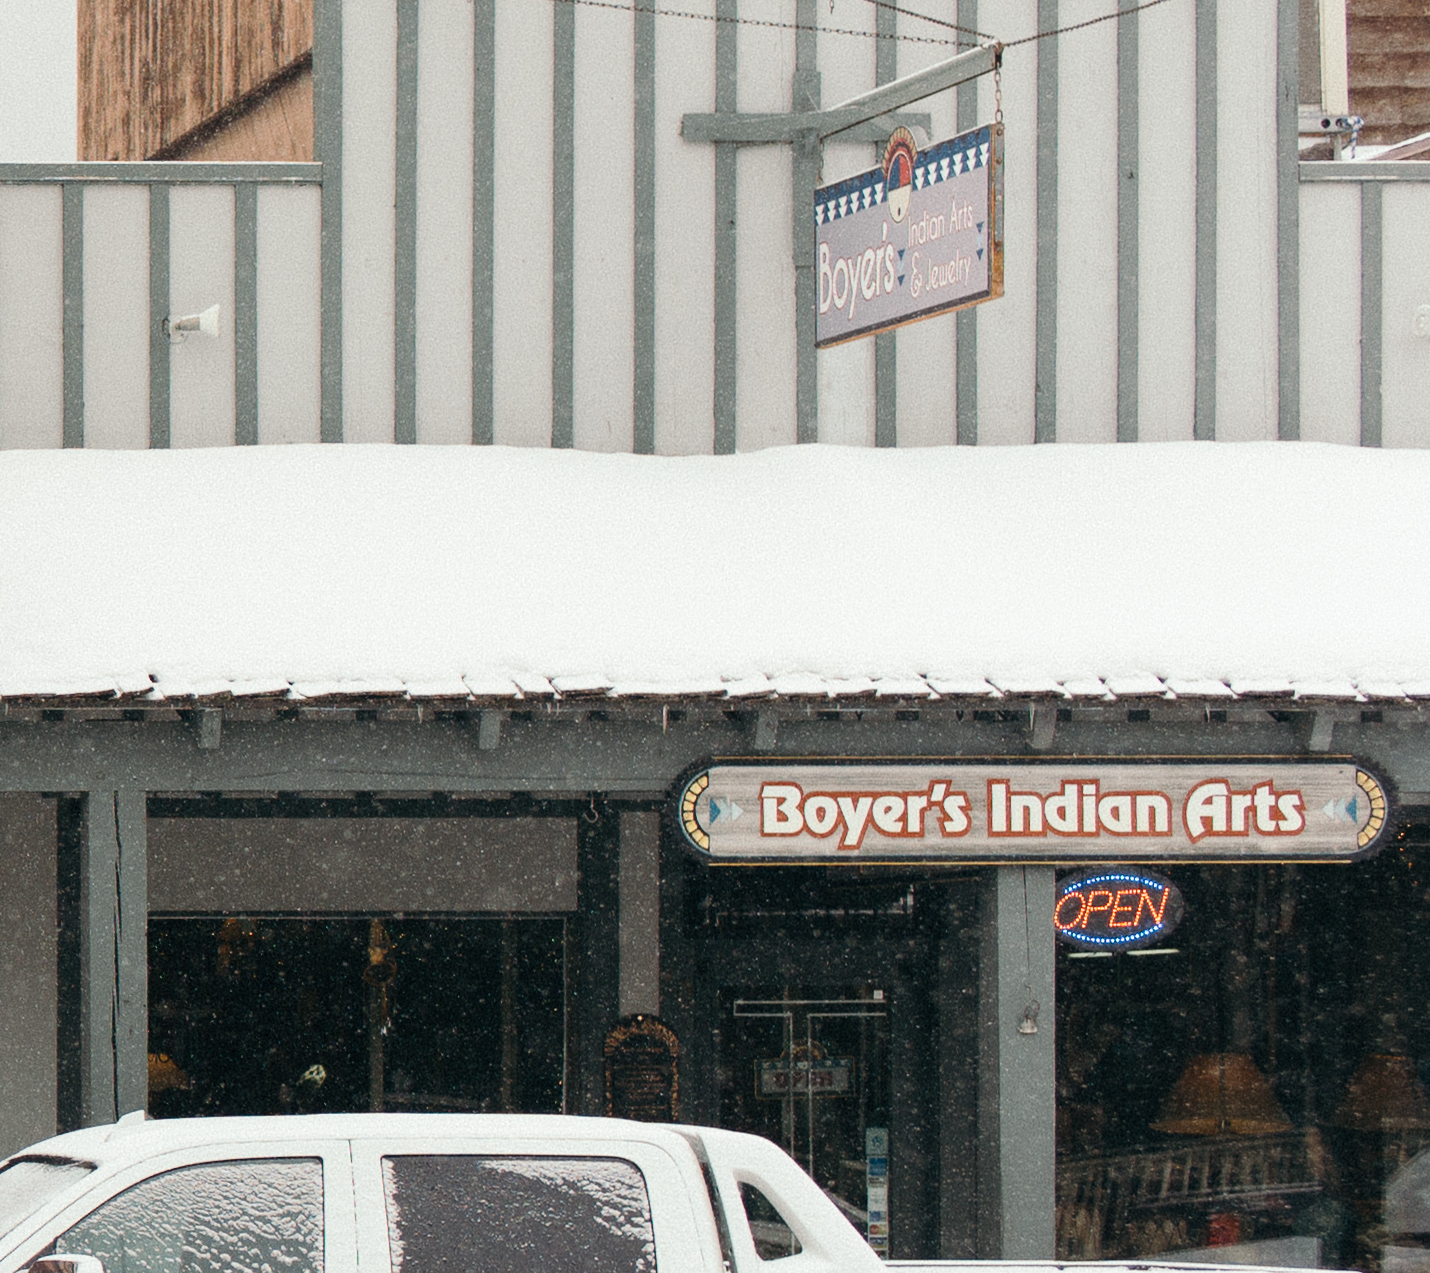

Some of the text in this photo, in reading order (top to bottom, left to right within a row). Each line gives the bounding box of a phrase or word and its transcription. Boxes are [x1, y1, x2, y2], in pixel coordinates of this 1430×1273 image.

[908, 200, 973, 252] Indian Arts
[818, 220, 894, 319] Boyer's
[910, 250, 973, 298] & Jewelry
[759, 778, 1307, 850] Boyer's Indian Arts
[1053, 887, 1171, 930] OPEN
